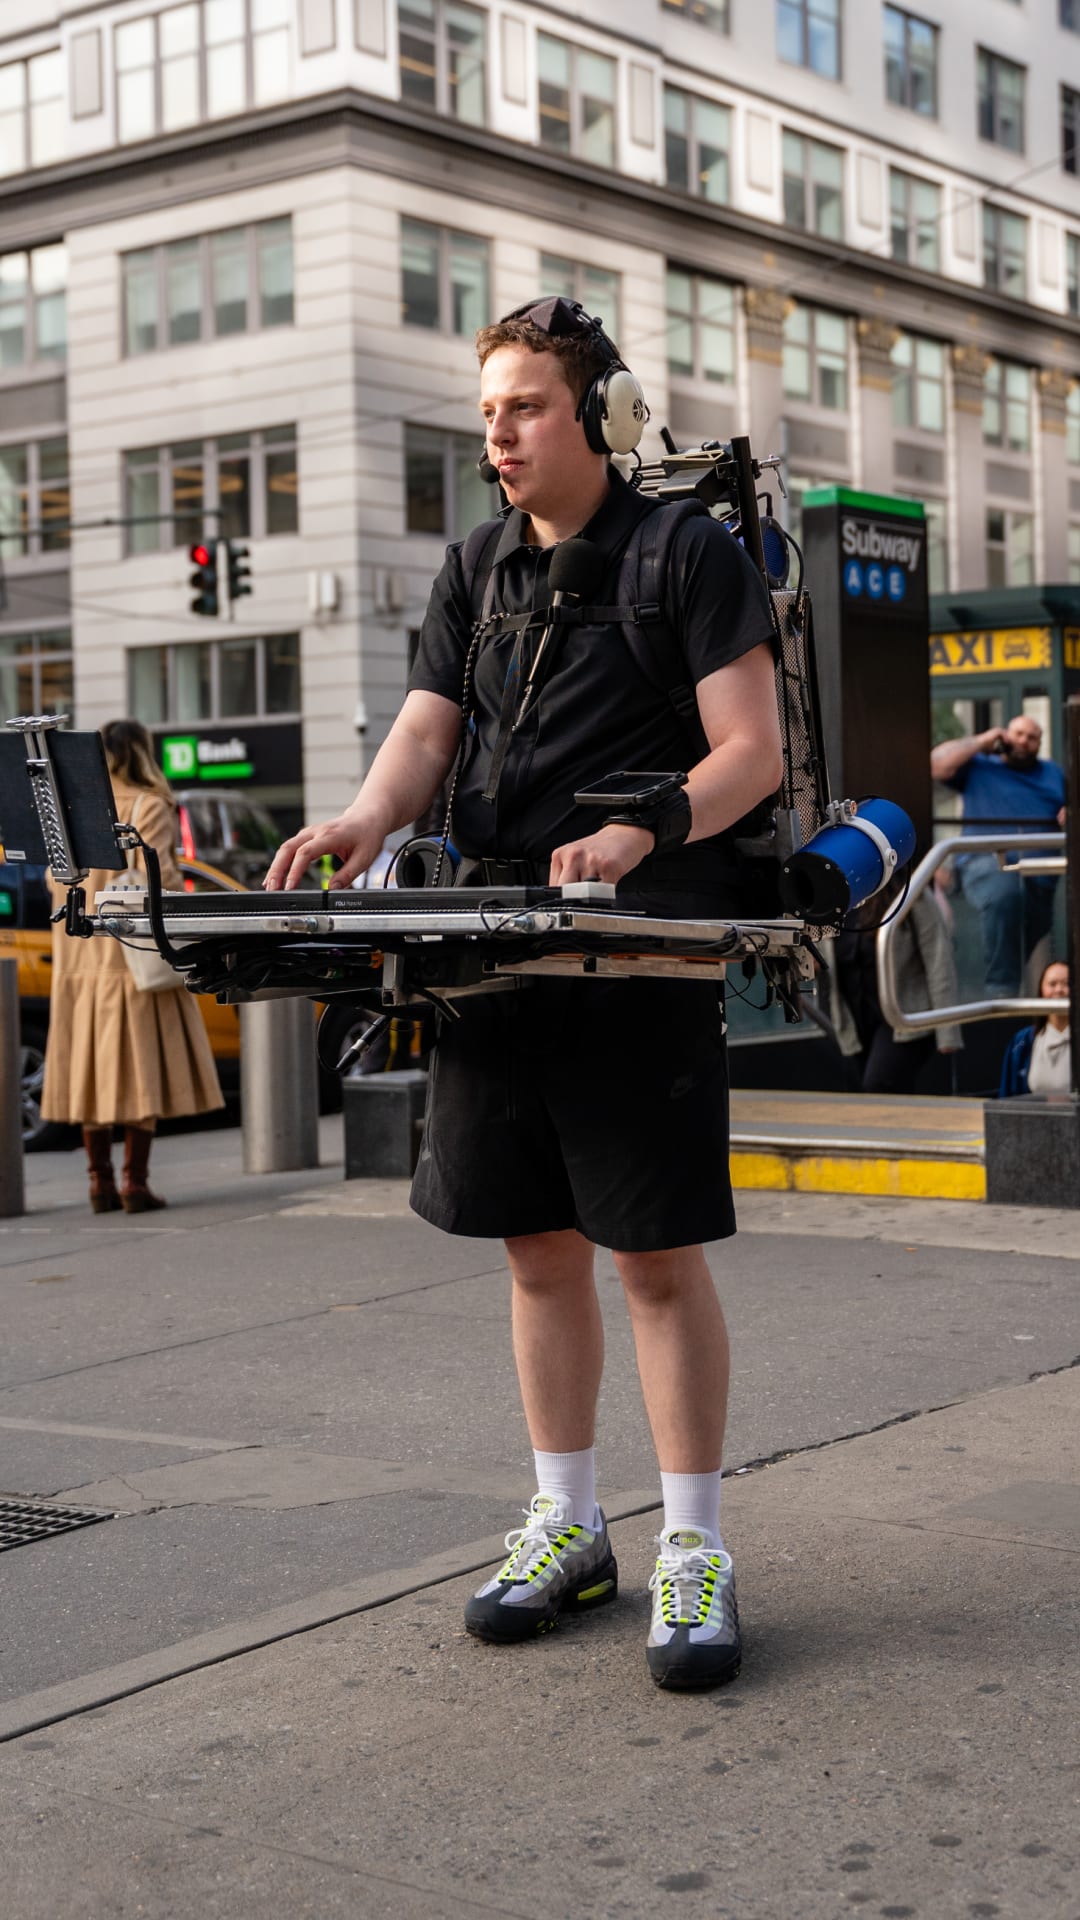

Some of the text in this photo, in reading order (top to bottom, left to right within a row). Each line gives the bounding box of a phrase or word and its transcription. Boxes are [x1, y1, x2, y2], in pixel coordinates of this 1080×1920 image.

[842, 519, 921, 572] Subway
[847, 565, 902, 596] A C E
[165, 738, 248, 771] TD Bank
